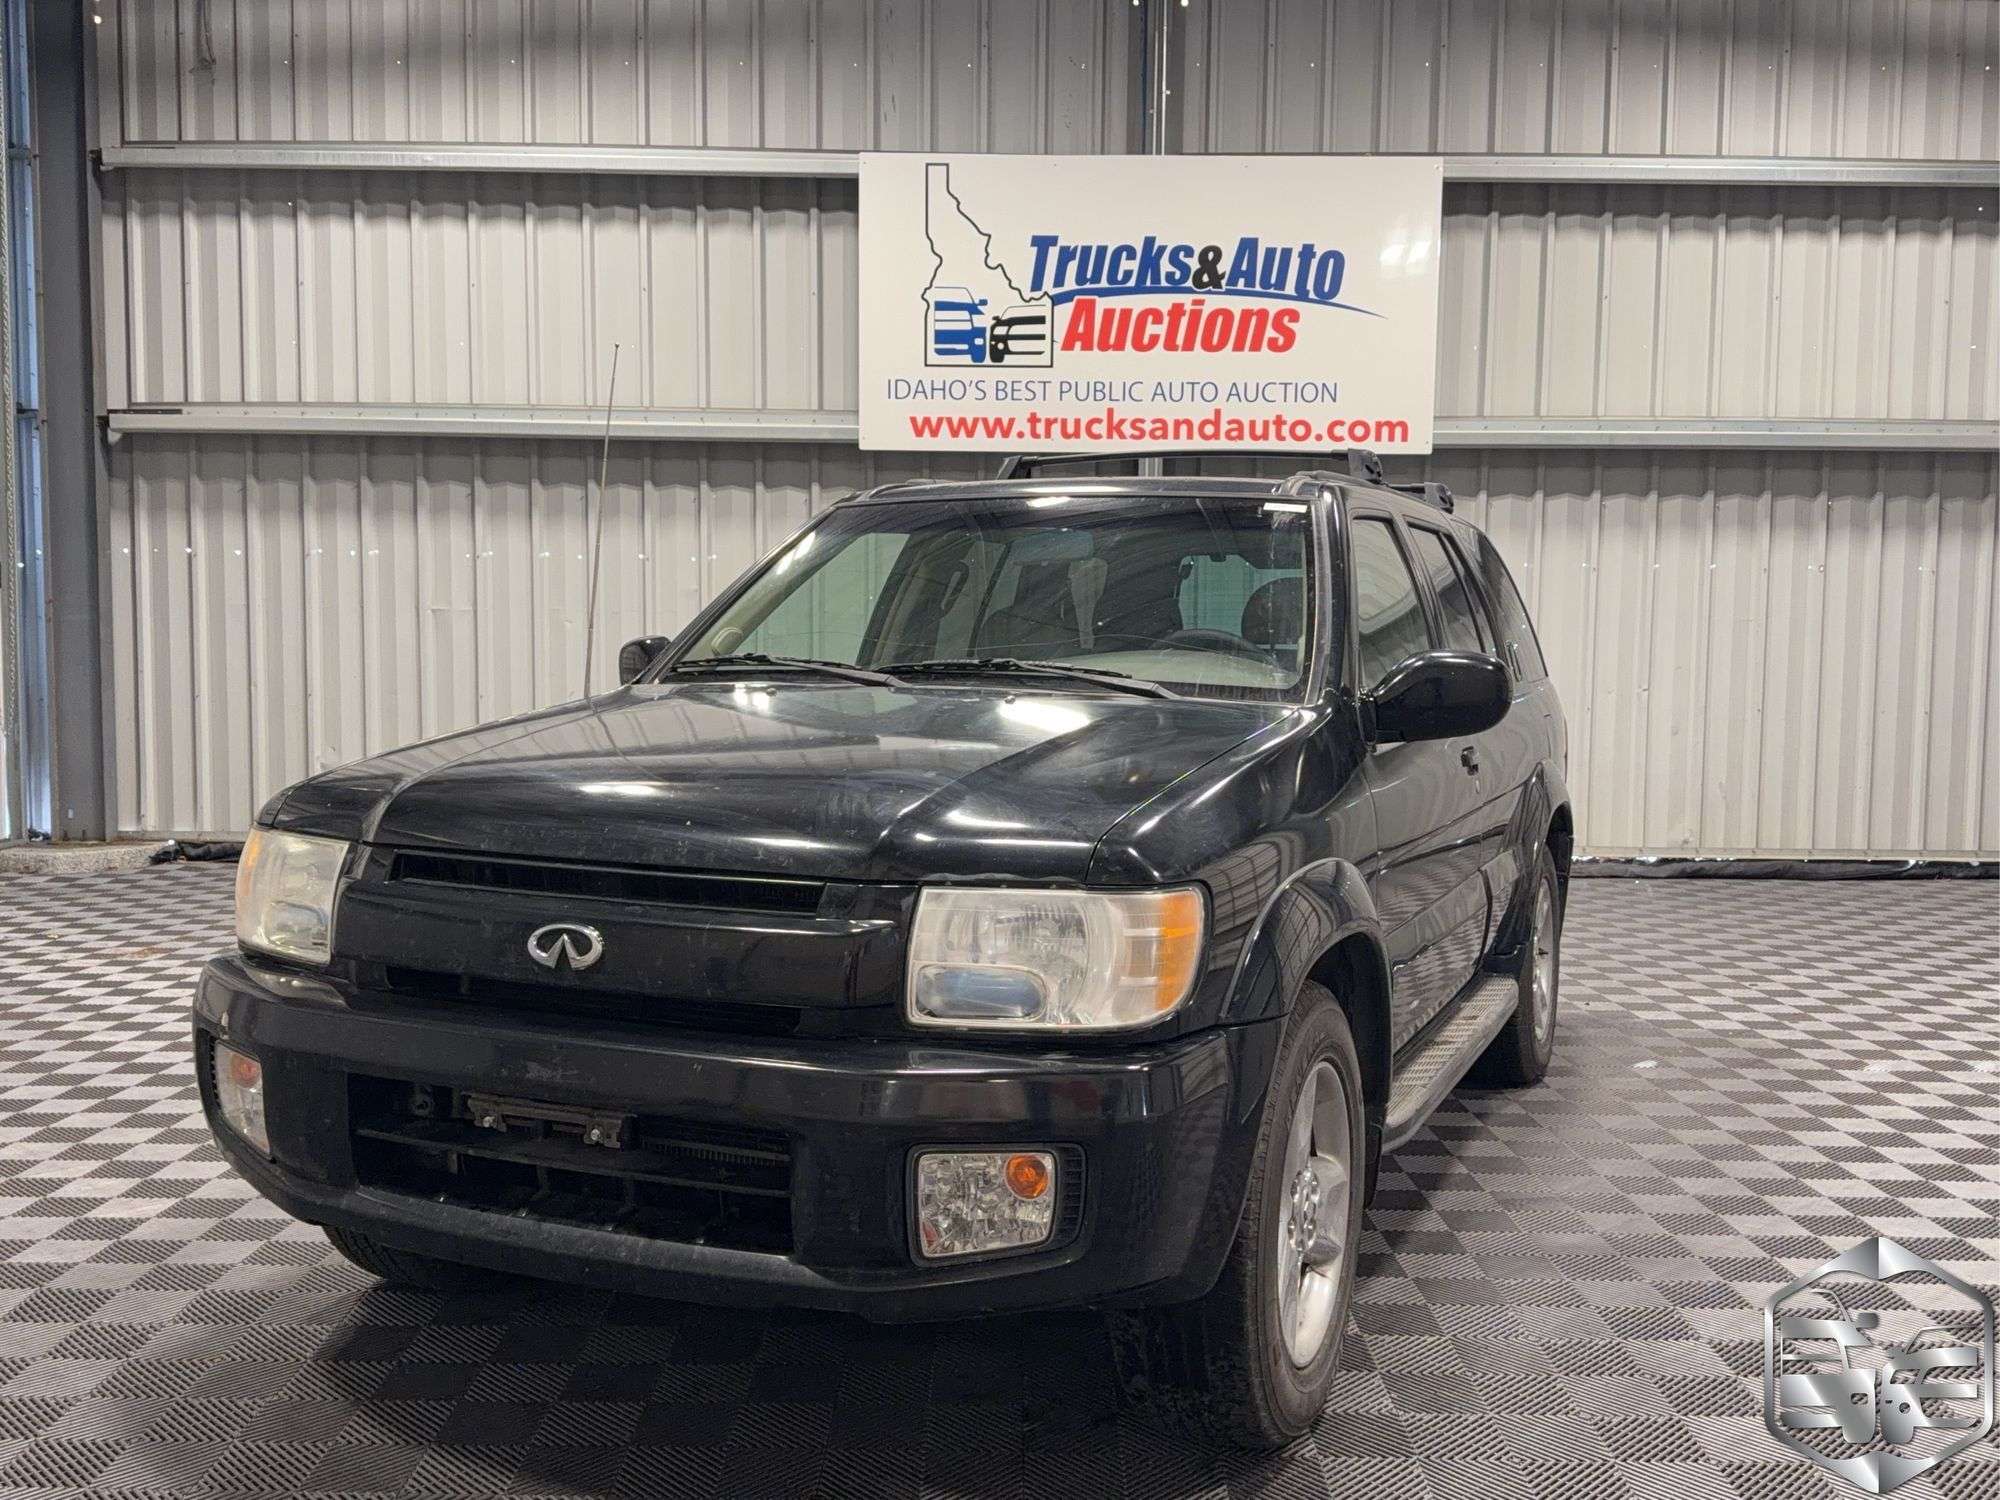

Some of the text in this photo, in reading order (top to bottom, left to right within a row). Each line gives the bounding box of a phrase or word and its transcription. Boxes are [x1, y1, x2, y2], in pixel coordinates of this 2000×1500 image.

[1030, 234, 1346, 300] Trucks&Auto
[1061, 298, 1300, 353] Auctions
[887, 379, 1338, 403] IDAHO'S BEST PUBLIC AUTO AUCTION
[909, 408, 1409, 443] www.trucksandauto.com
